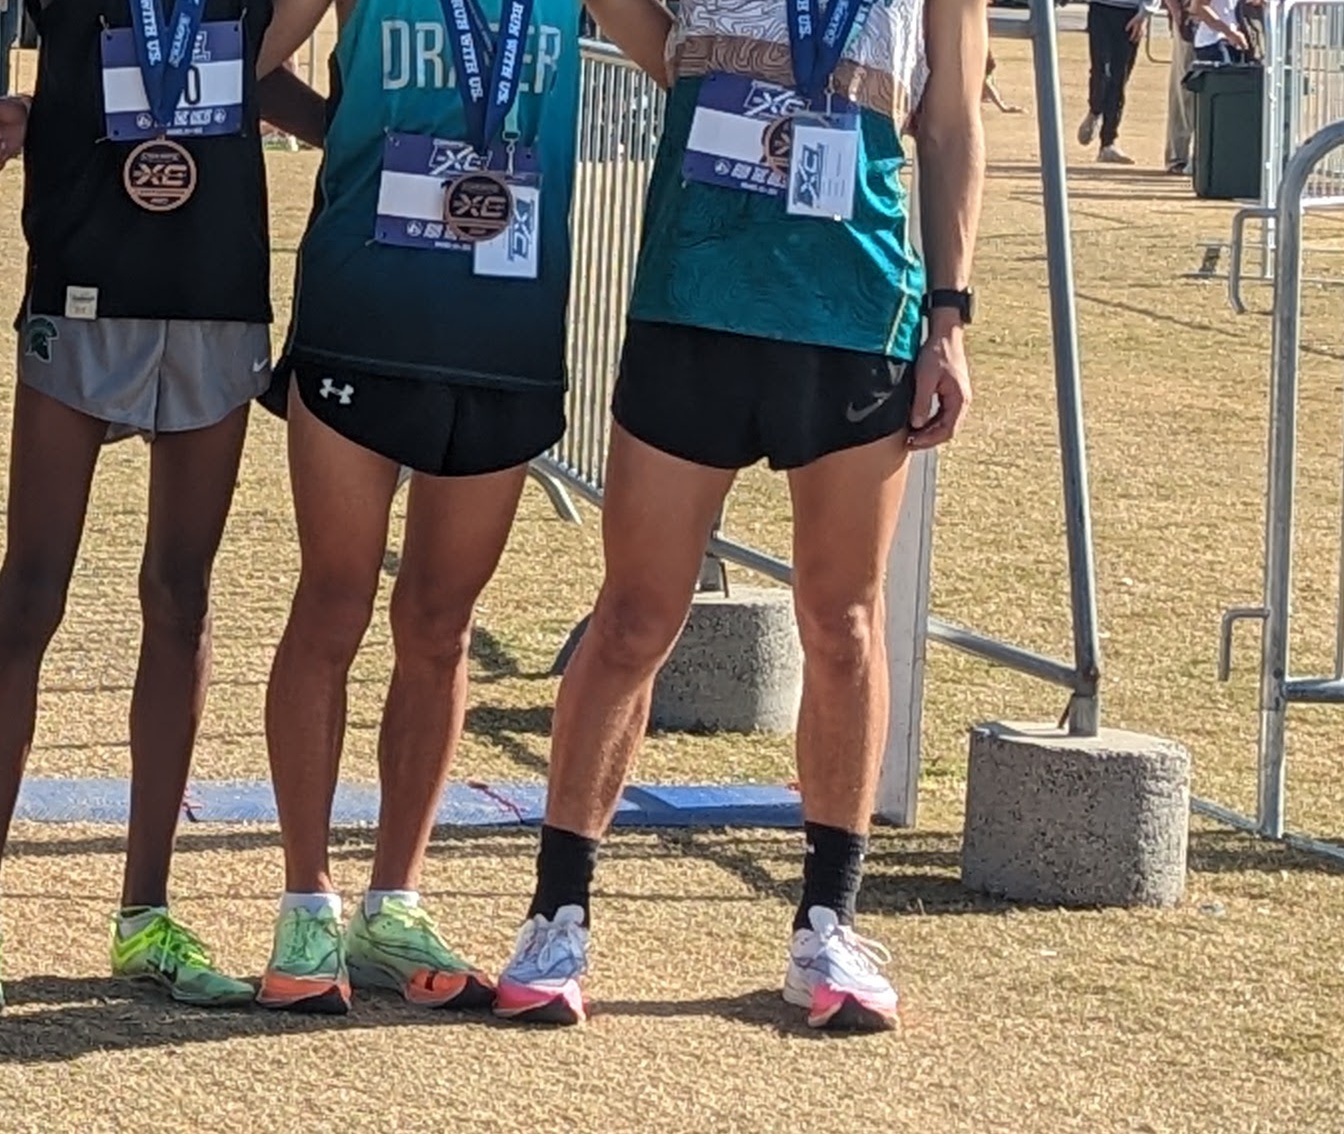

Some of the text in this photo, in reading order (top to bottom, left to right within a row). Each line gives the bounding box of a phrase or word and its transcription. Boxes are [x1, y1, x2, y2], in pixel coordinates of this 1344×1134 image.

[508, 1, 524, 38] RUN
[461, 33, 479, 74] WITH
[501, 39, 519, 80] WITH
